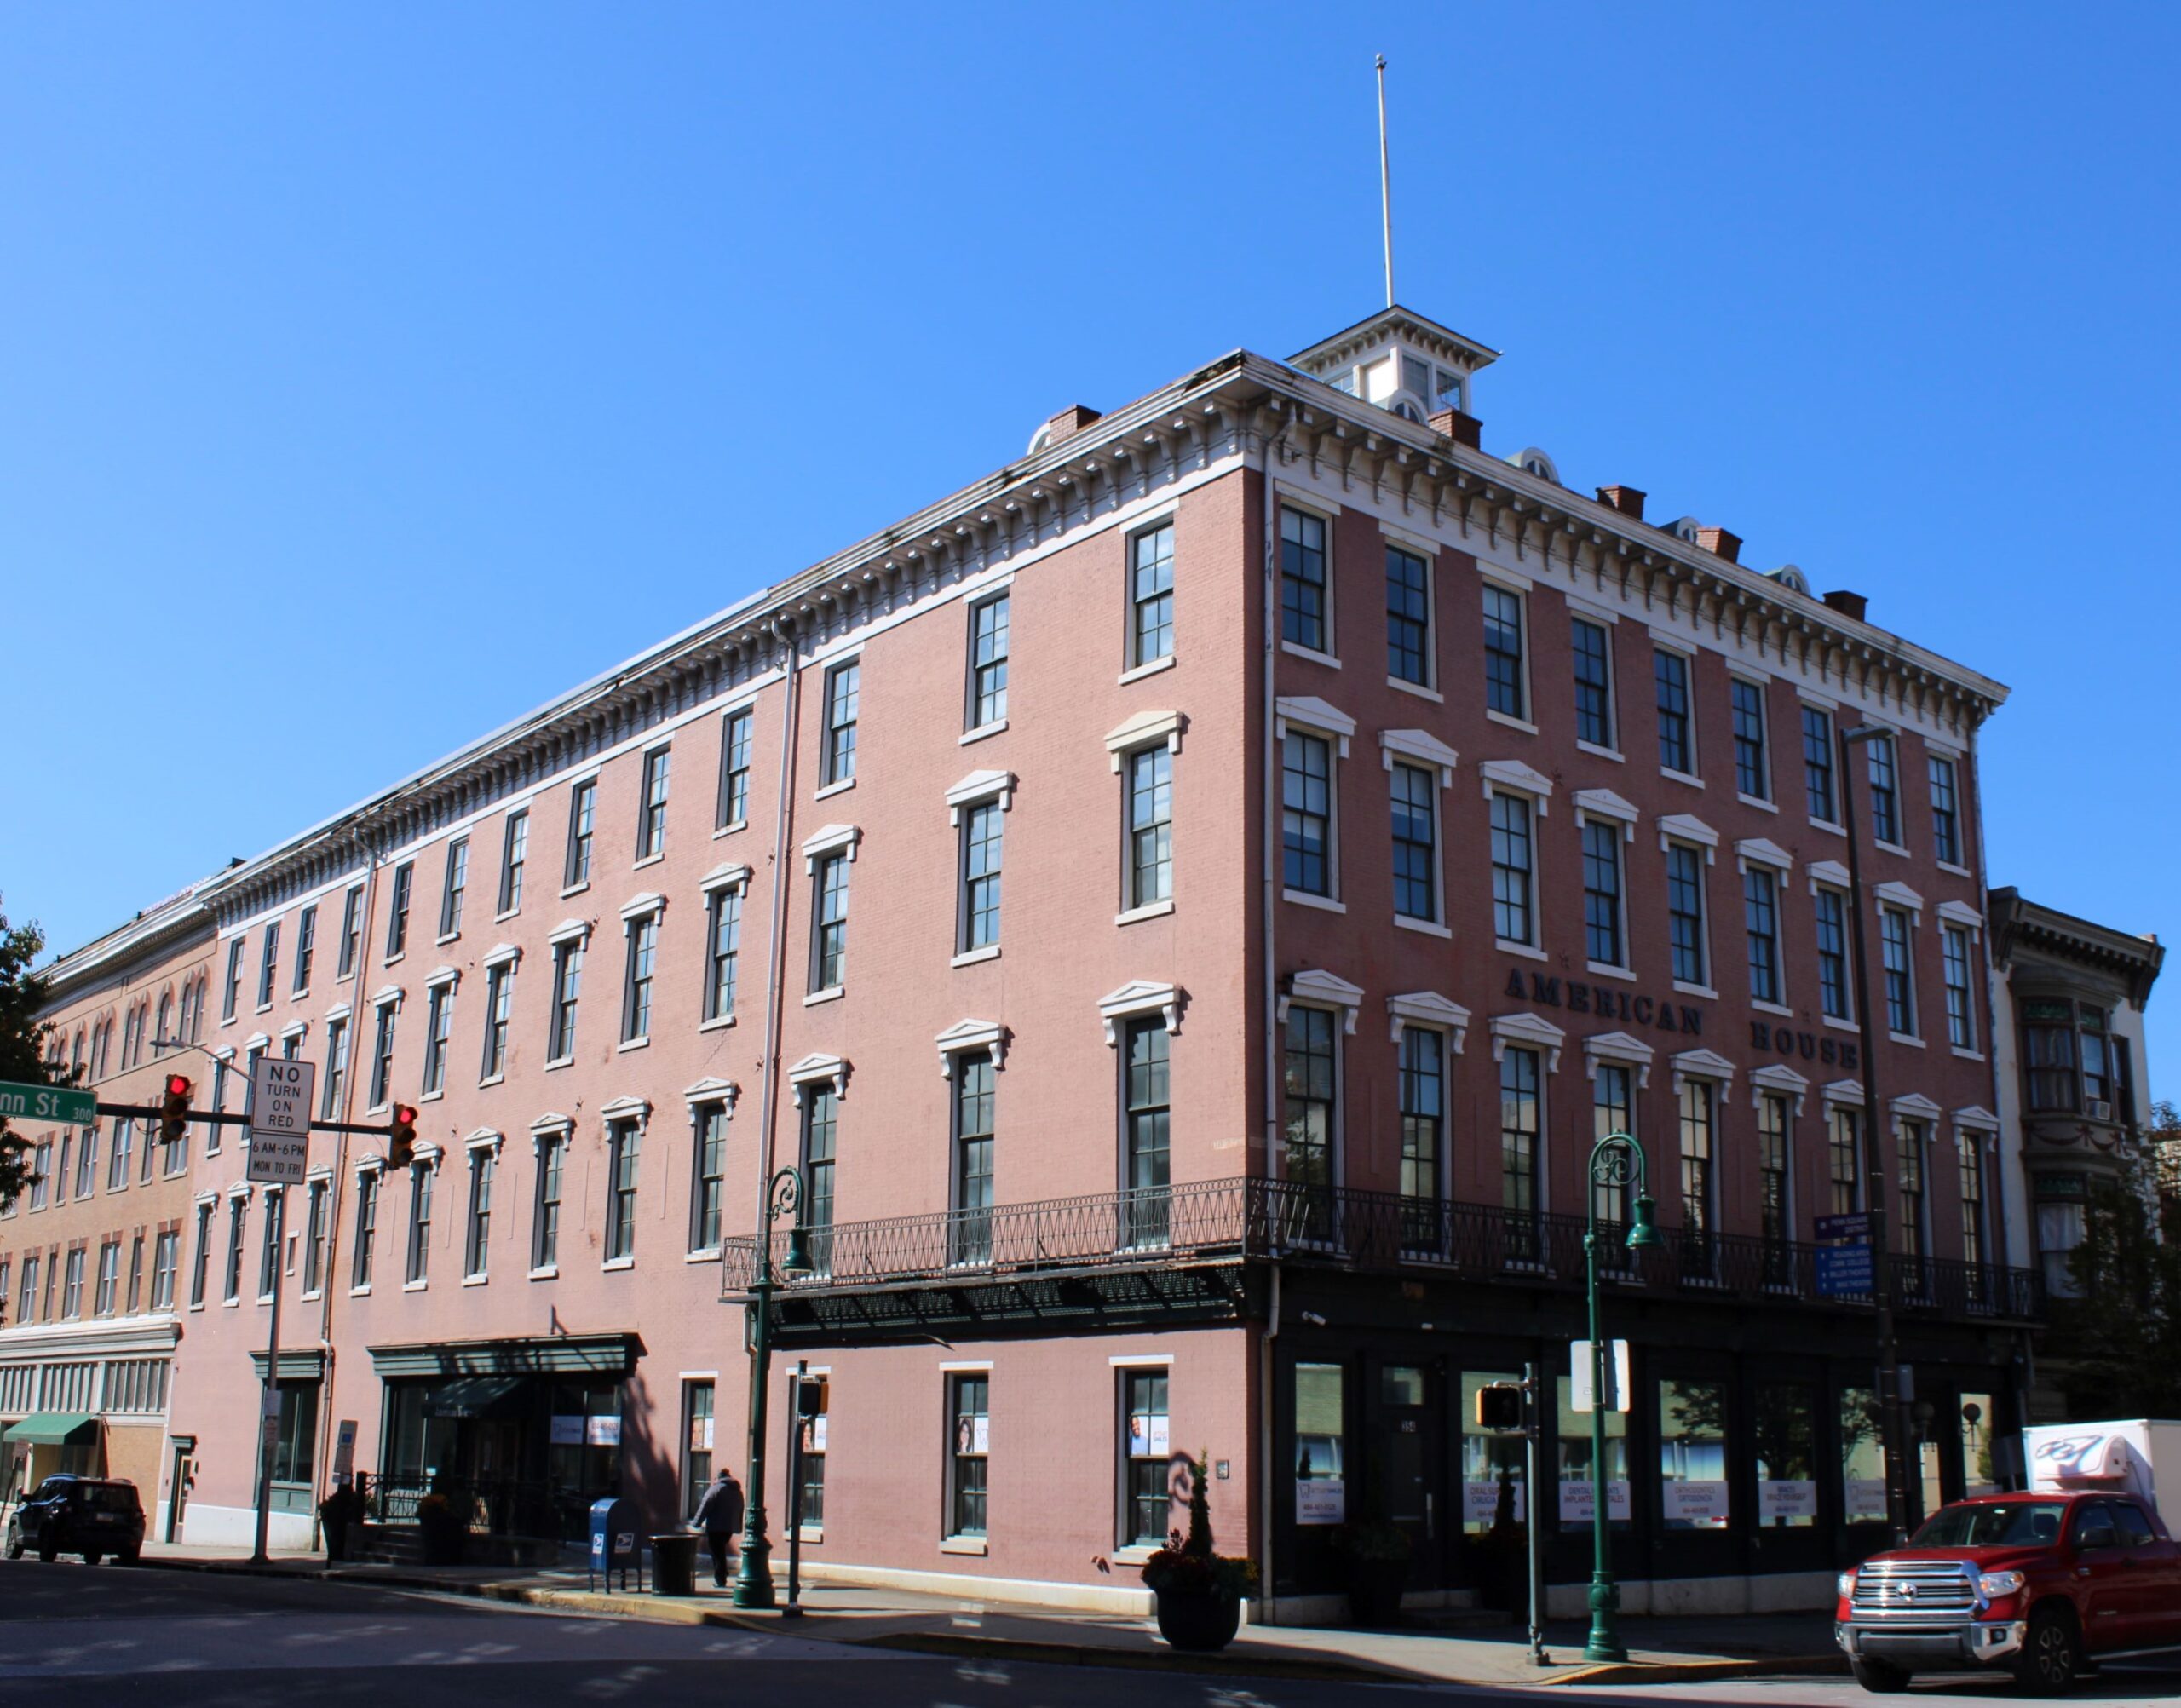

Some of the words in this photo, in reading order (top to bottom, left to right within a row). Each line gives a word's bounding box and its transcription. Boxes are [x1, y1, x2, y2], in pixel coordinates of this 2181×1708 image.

[1505, 968, 1703, 1035] AMERICAN
[1749, 1020, 1859, 1069] HOUSE
[270, 1065, 300, 1083] NO
[266, 1084, 300, 1098] TURN
[36, 1092, 60, 1118] St
[72, 1107, 92, 1122] 300
[273, 1100, 292, 1113] ON
[268, 1114, 294, 1128] RED
[291, 1144, 305, 1157] PM
[253, 1159, 270, 1173] MON
[275, 1162, 285, 1174] TO
[288, 1163, 301, 1176] FRI
